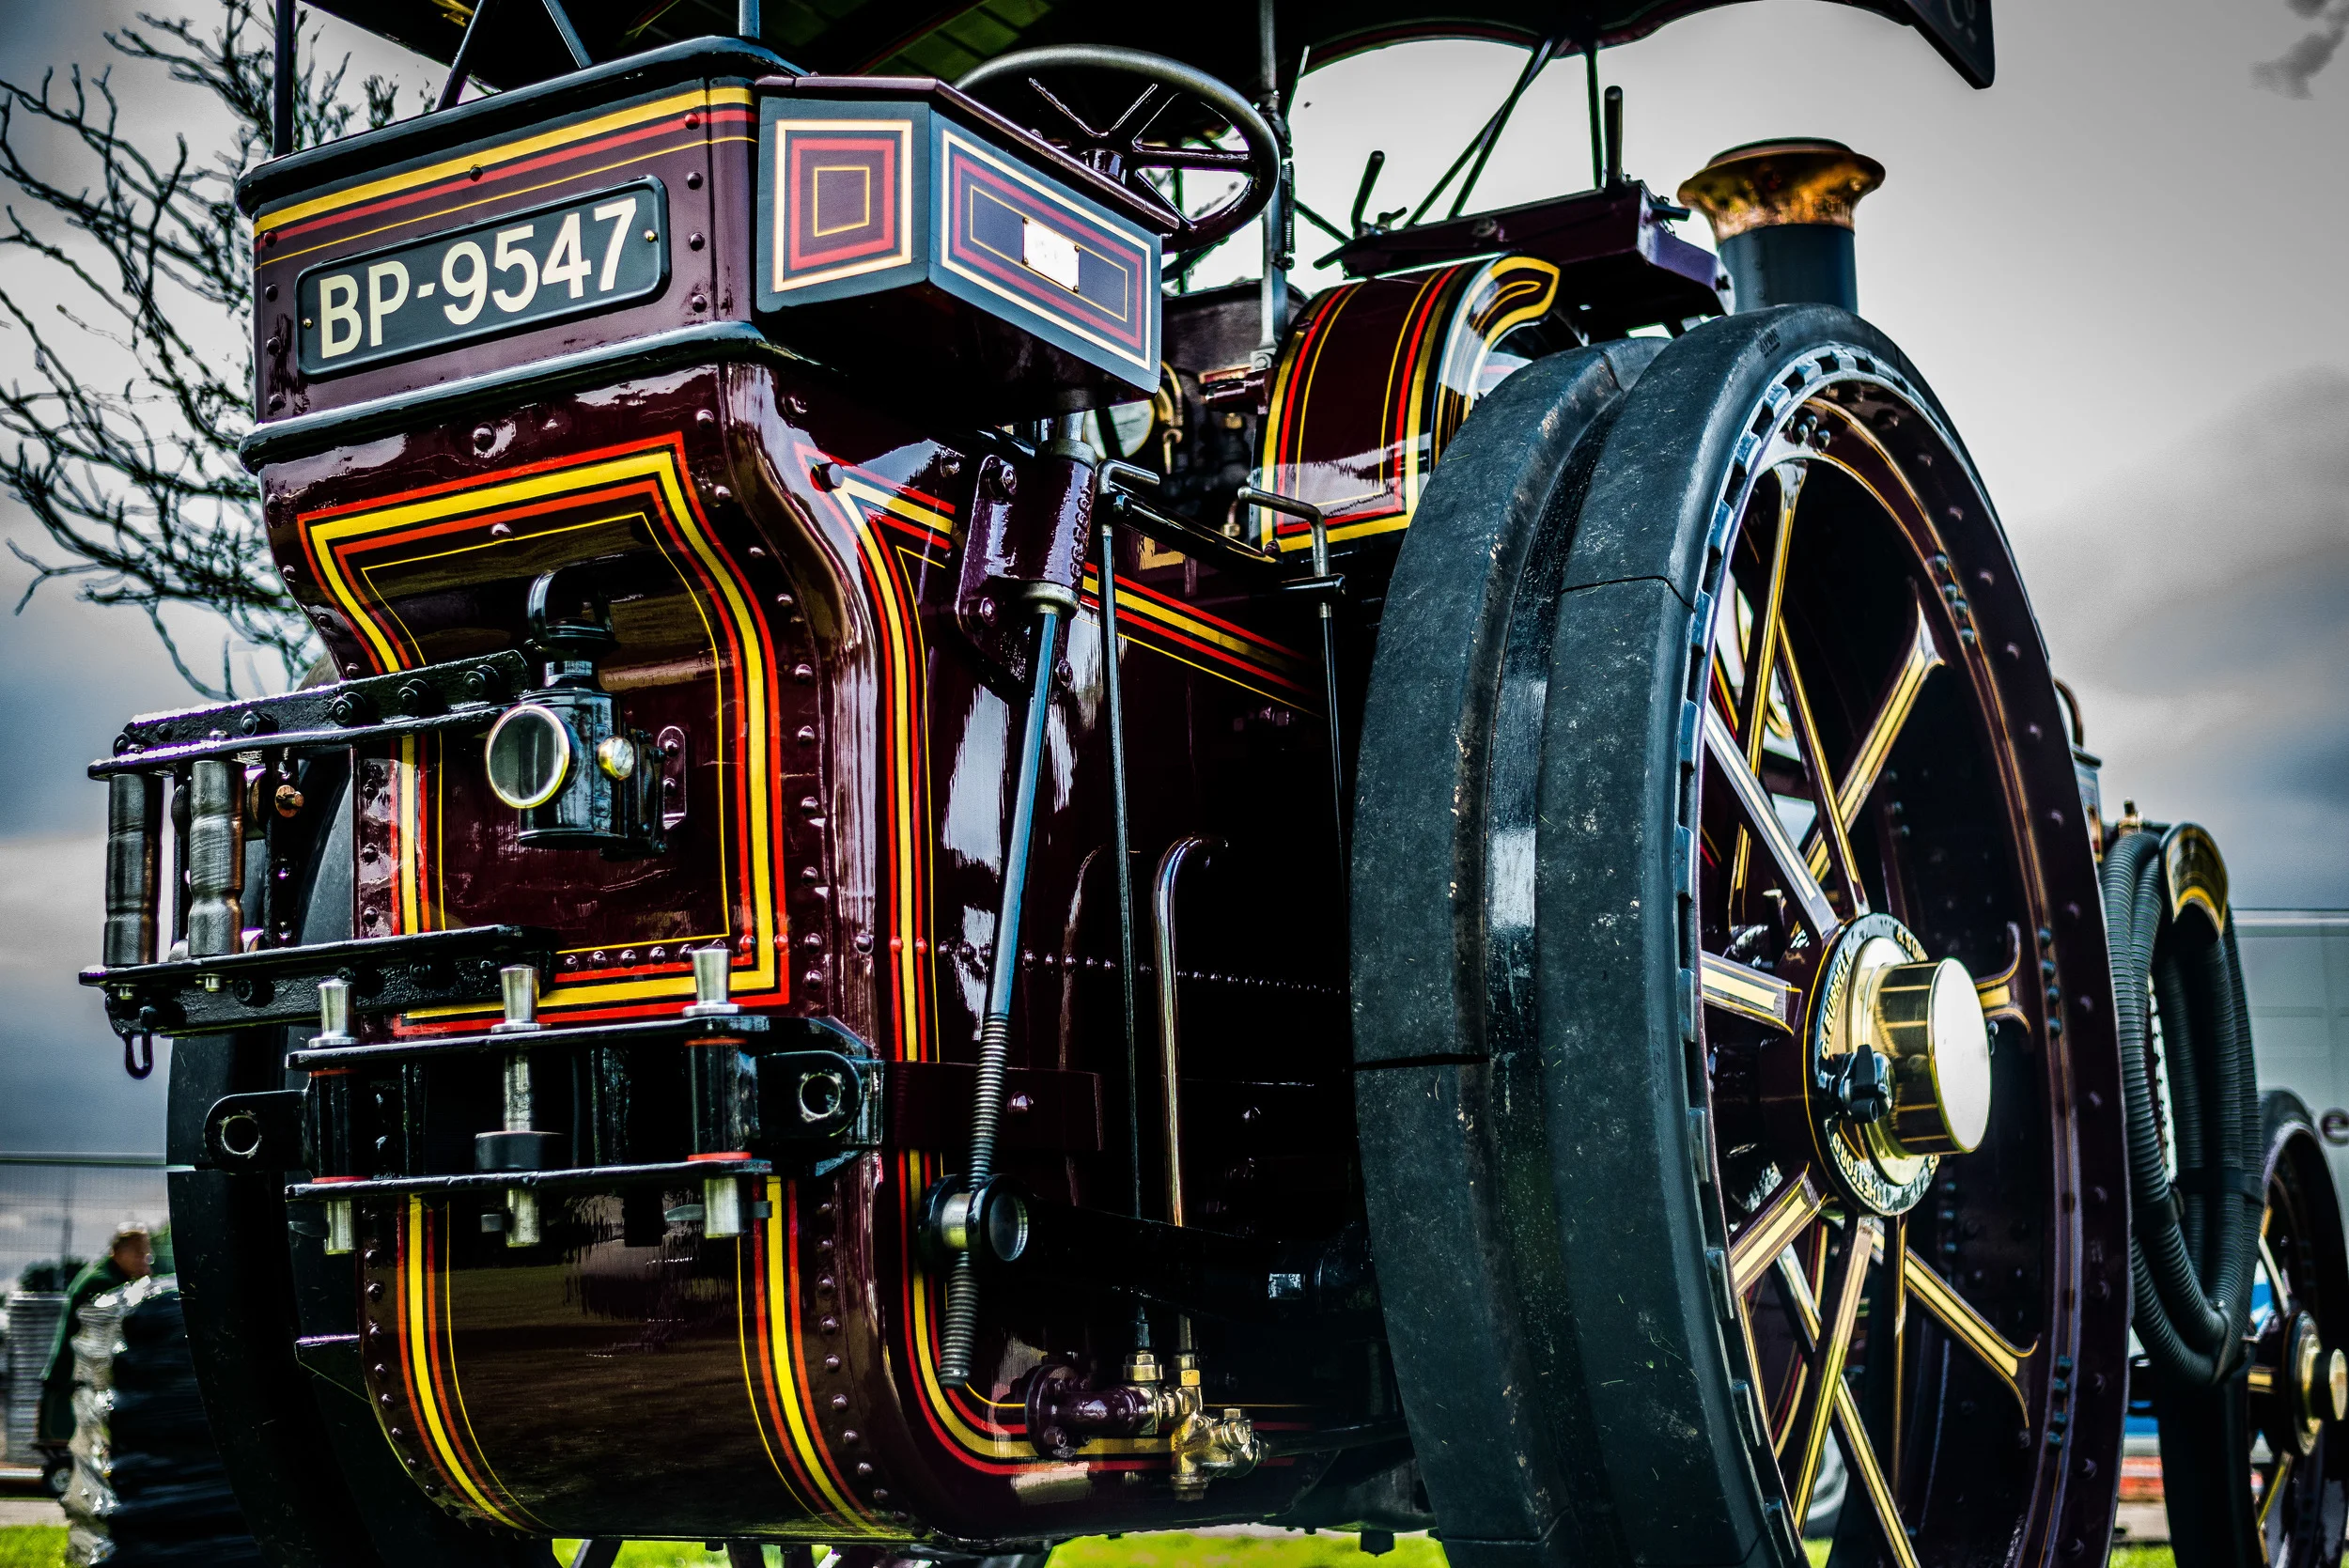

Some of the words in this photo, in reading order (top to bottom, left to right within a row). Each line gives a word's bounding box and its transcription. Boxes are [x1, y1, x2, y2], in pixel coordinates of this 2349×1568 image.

[319, 197, 637, 359] BP-9547
[1824, 947, 1853, 1034] BURRELL
[1832, 1131, 1883, 1209] THETFORD
